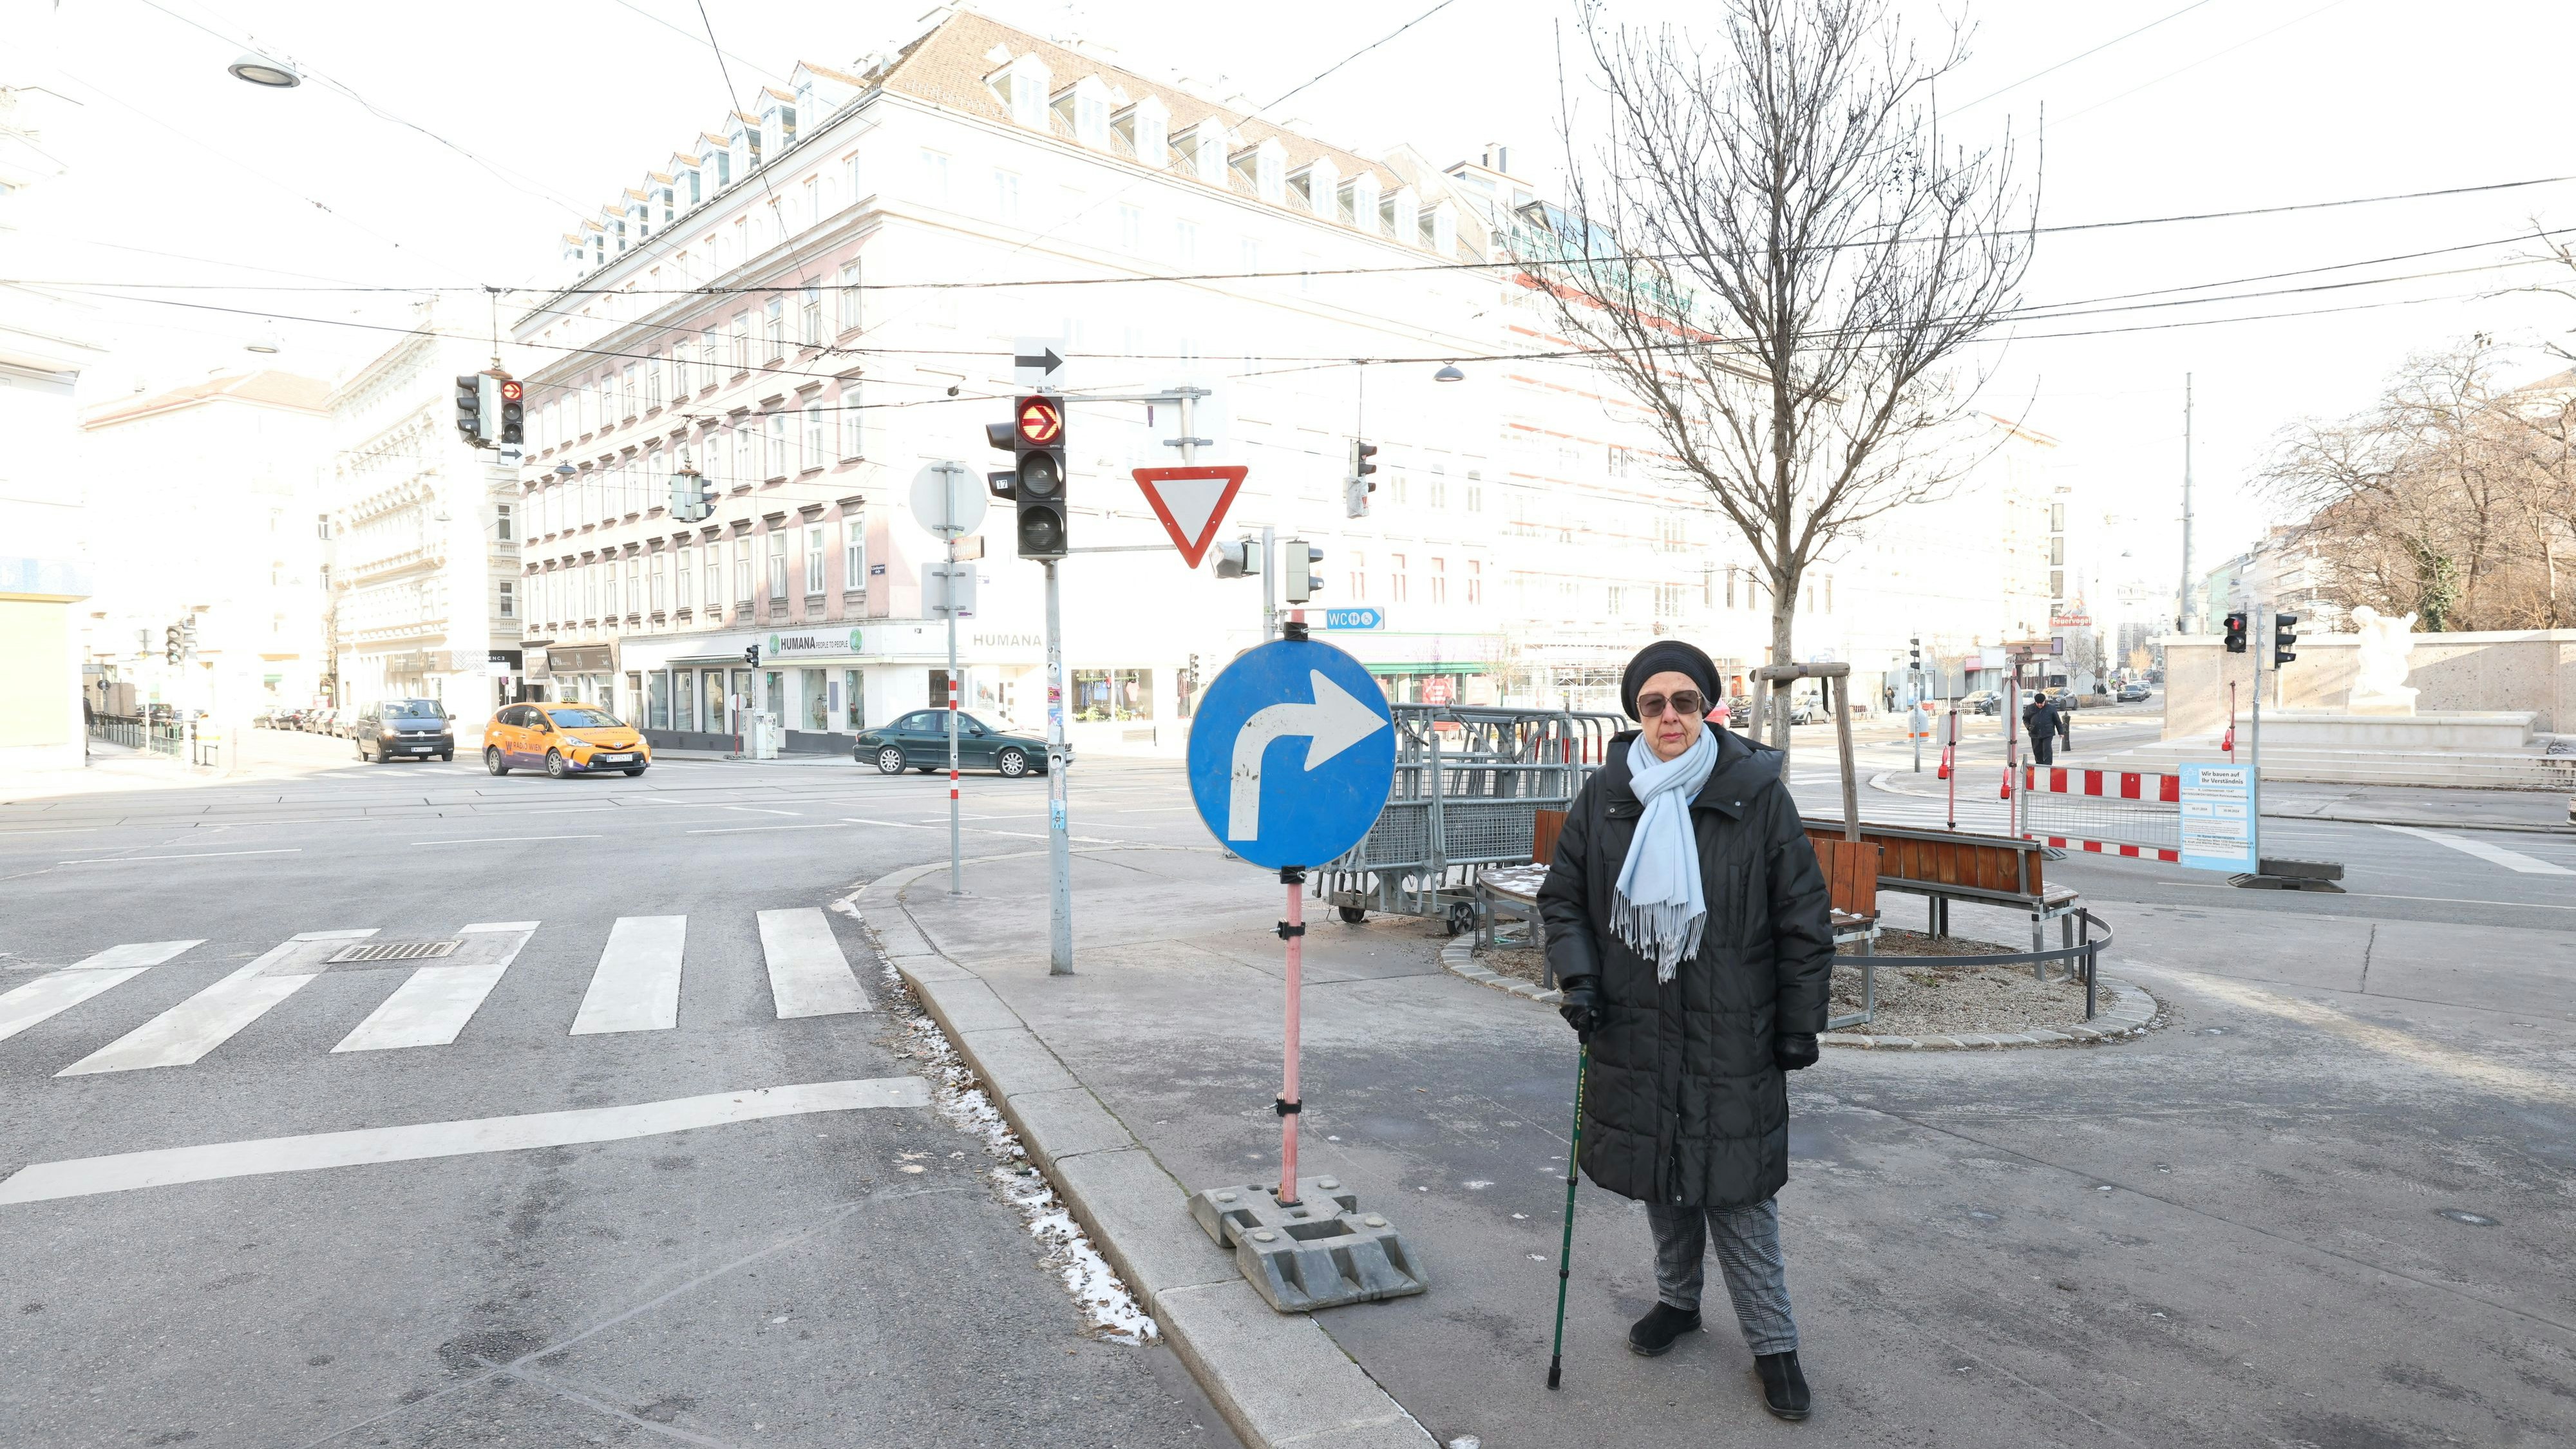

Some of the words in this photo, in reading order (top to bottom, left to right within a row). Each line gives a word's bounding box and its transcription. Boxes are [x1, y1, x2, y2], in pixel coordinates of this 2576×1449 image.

[951, 545, 972, 557] POLIZEI
[1329, 613, 1347, 626] WC
[2052, 616, 2091, 625] Feuervogel
[781, 636, 816, 650] HUMANA
[973, 634, 1042, 647] HUMANA
[506, 741, 512, 752] W
[513, 742, 528, 751] RADIO
